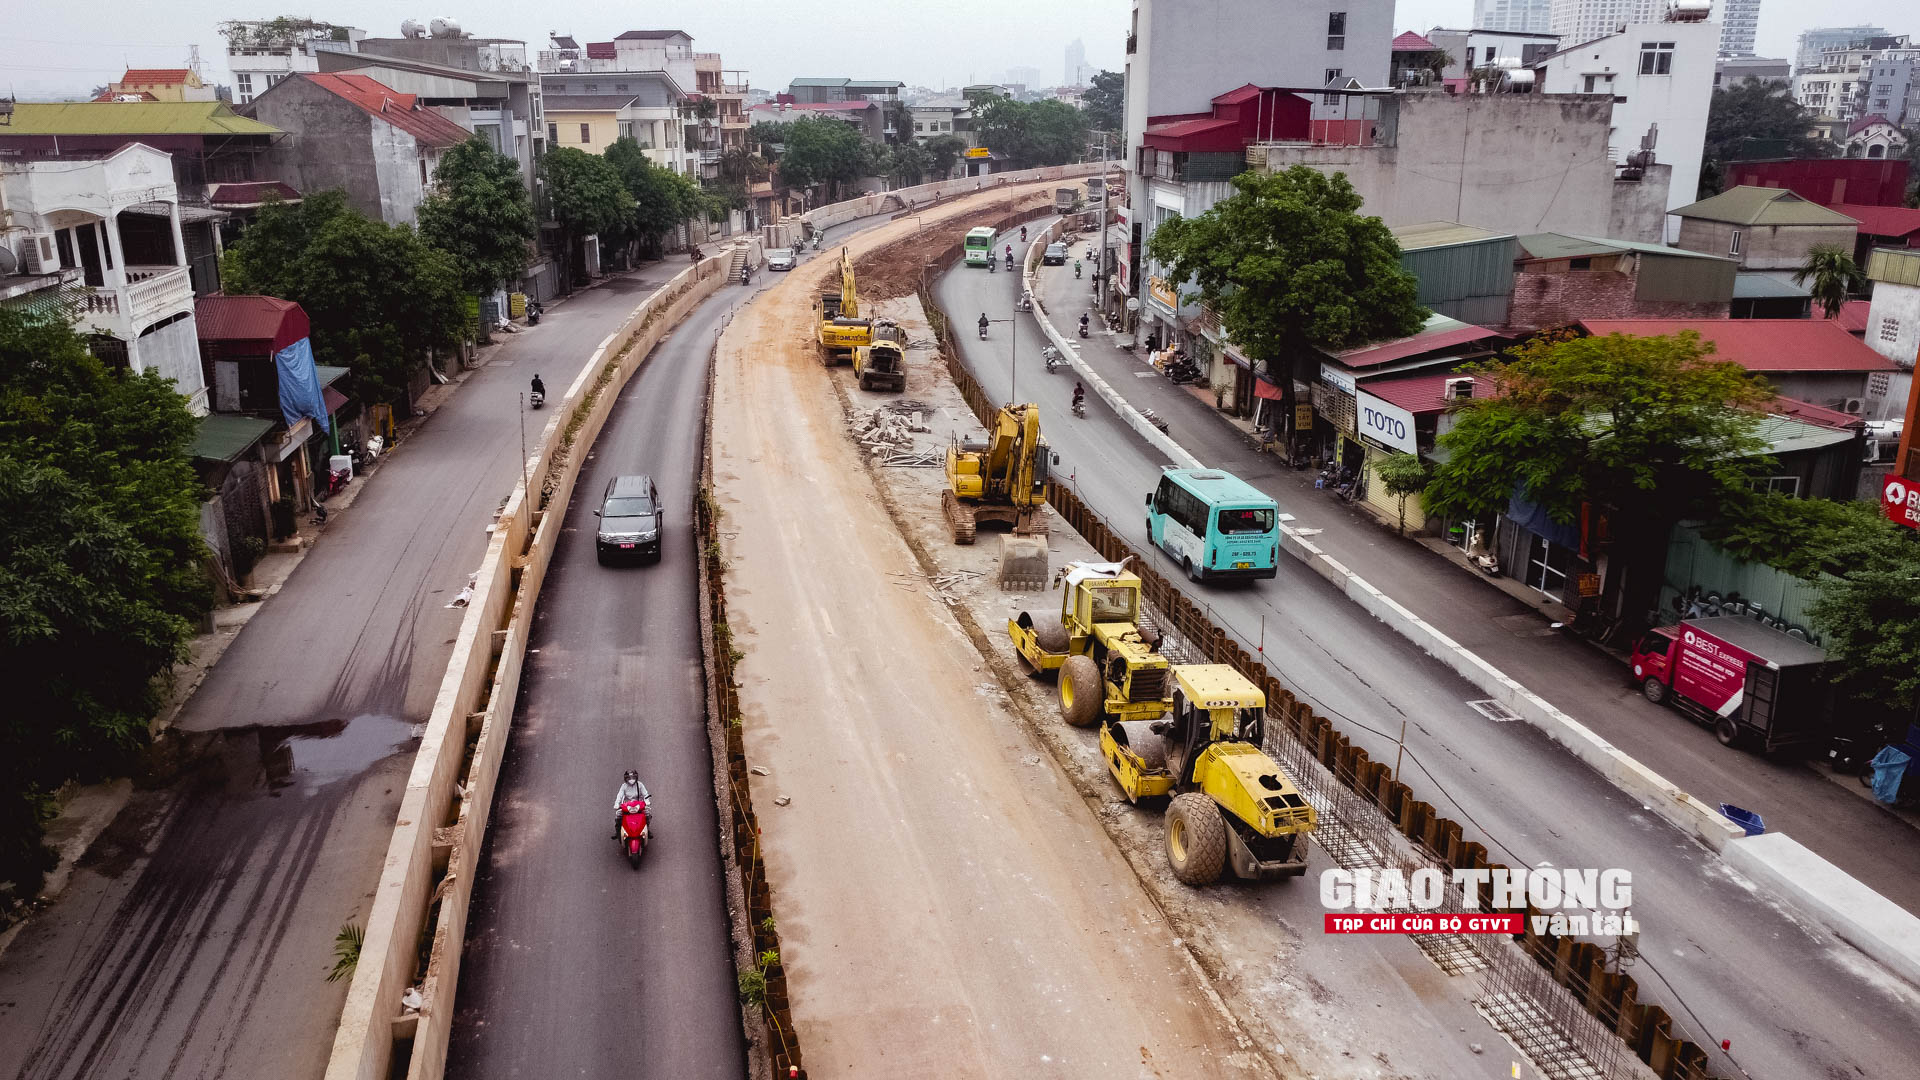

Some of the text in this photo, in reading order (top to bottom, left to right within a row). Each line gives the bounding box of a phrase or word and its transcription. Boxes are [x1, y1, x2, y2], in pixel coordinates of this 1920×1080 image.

[1364, 407, 1406, 440] TOTO
[1696, 636, 1720, 656] BEST
[1718, 651, 1744, 668] EXPRESS
